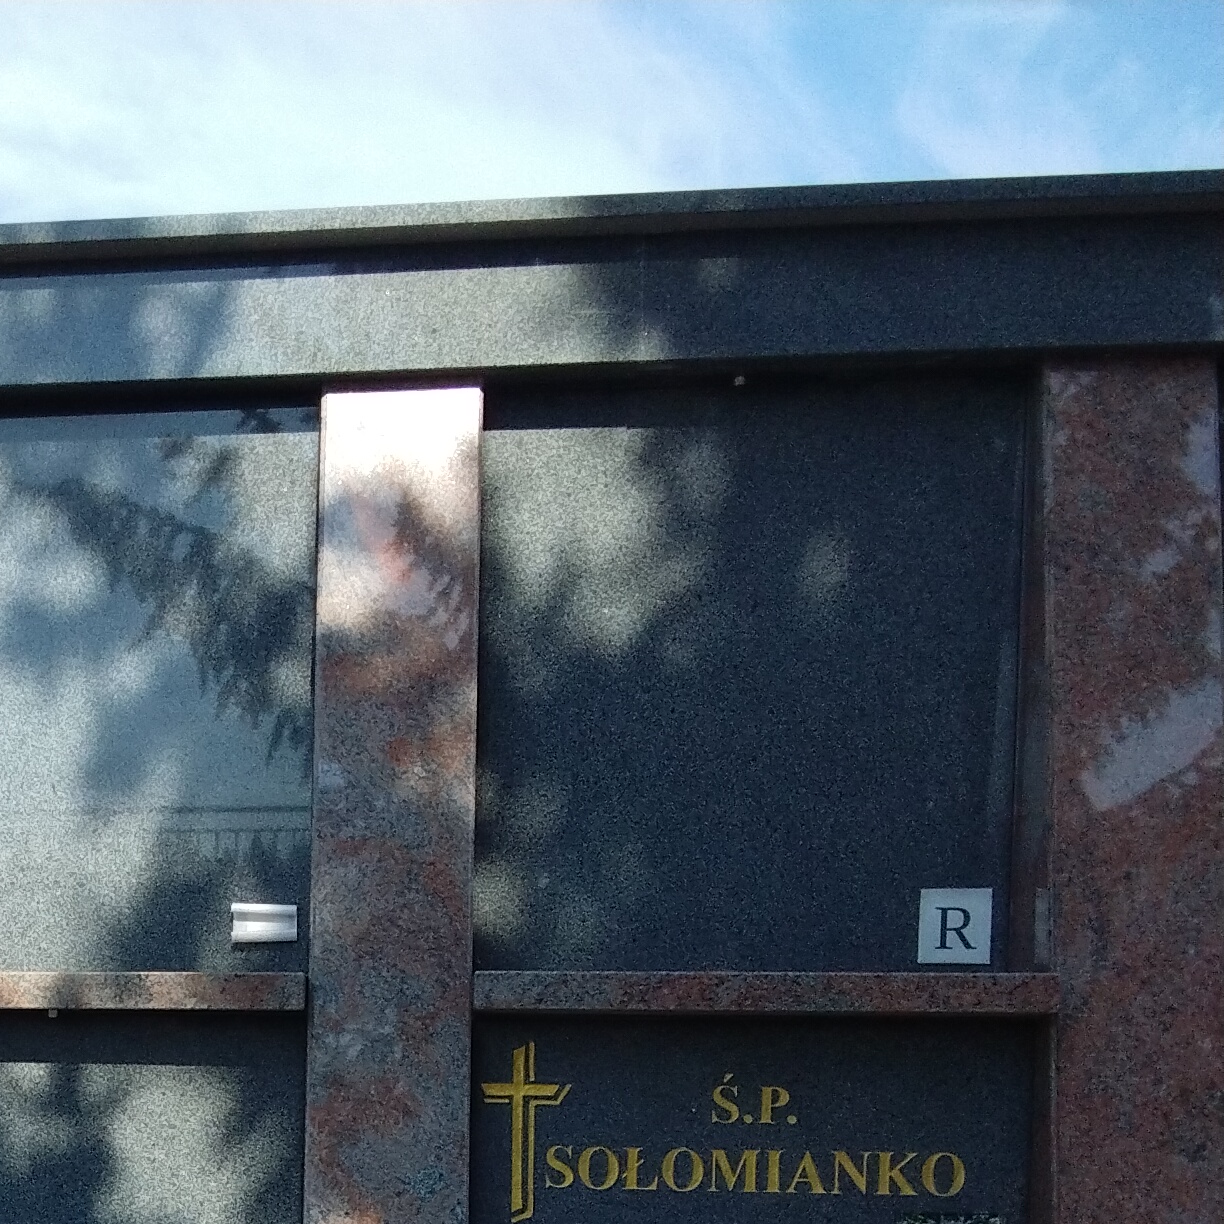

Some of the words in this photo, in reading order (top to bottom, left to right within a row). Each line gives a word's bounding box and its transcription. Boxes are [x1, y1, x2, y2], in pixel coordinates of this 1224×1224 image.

[935, 906, 977, 950] R
[711, 1073, 798, 1125] Ś.P.
[544, 1144, 967, 1198] SOŁOMIANKO
